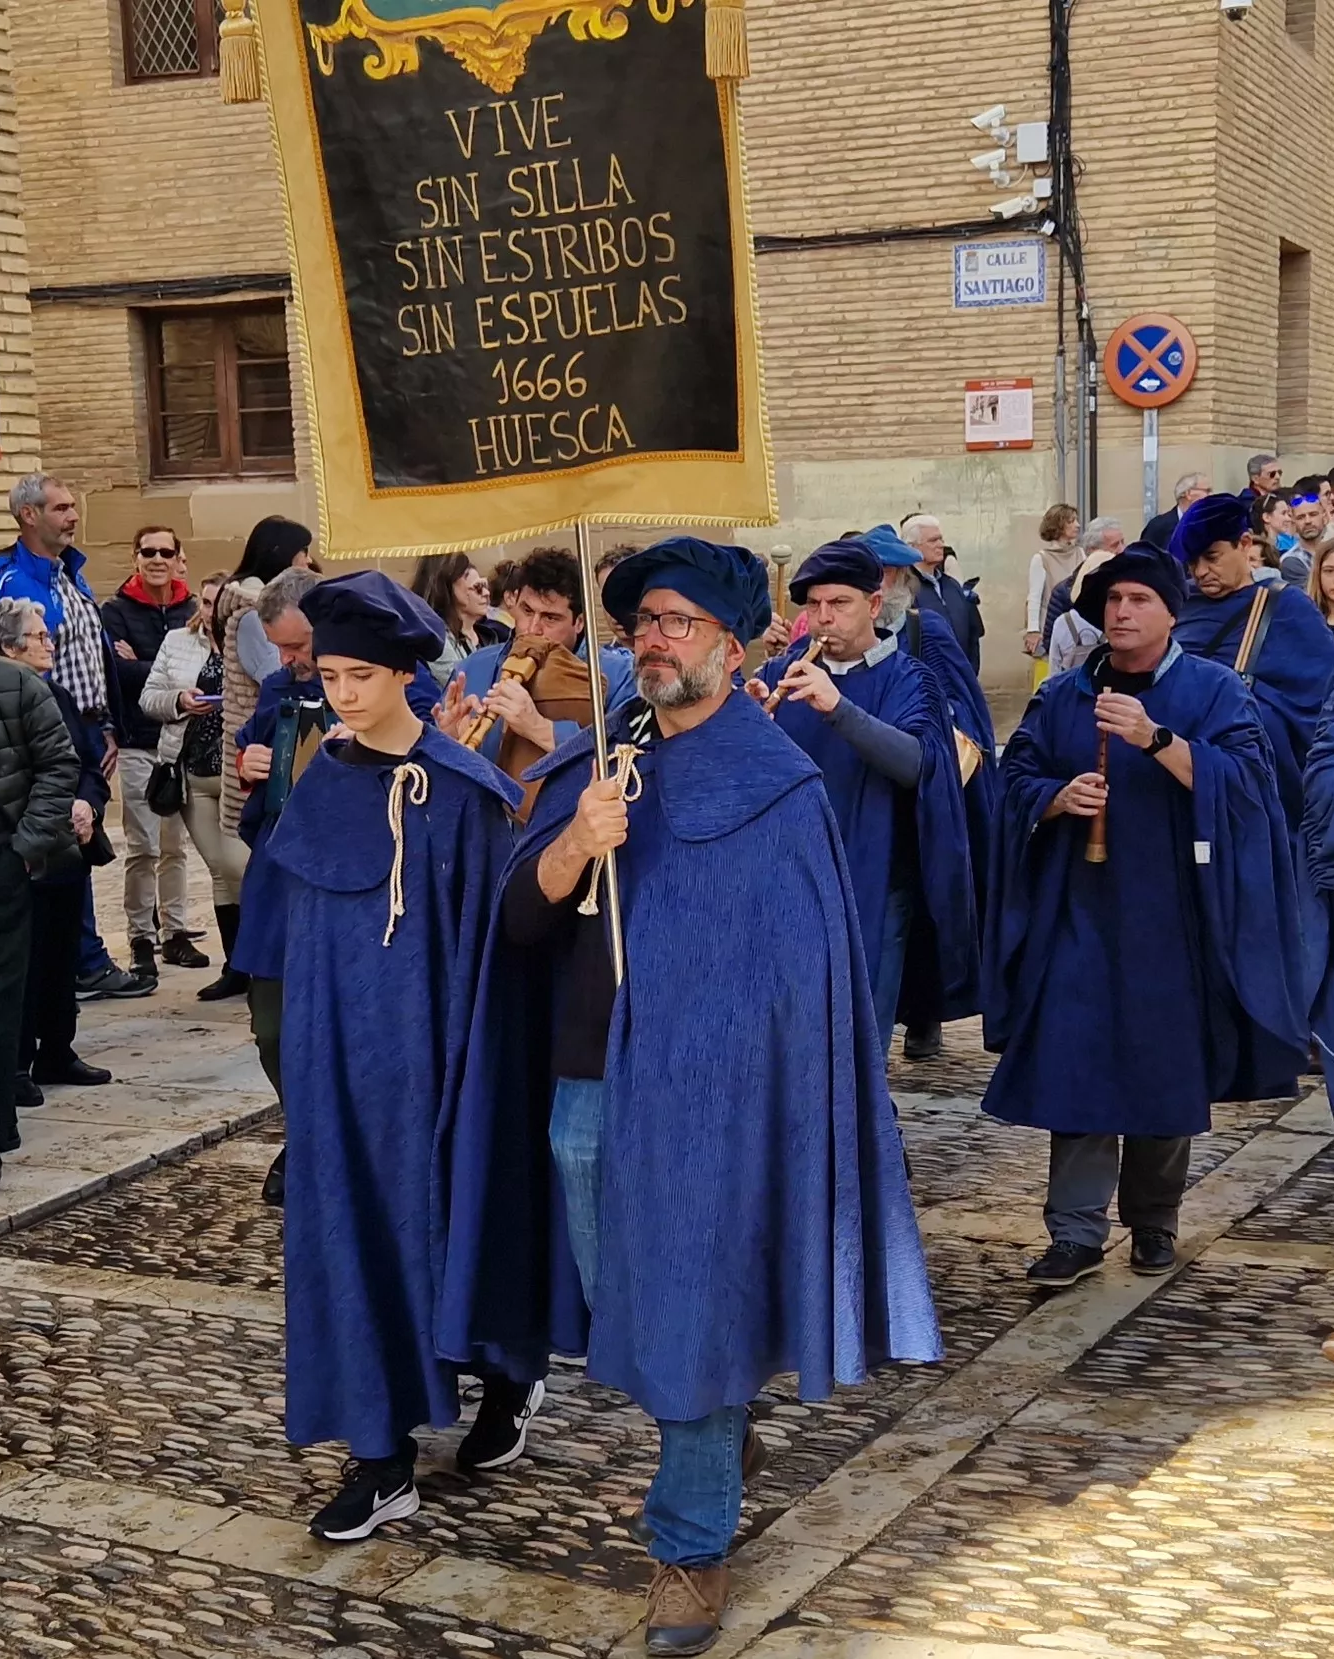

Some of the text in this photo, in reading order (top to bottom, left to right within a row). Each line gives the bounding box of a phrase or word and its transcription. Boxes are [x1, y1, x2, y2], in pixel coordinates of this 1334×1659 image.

[444, 91, 572, 160] VIVE
[416, 153, 637, 230] SIN SILLA
[394, 211, 678, 292] SIN ESTRIBOS
[964, 277, 1035, 296] SANTIAGO
[986, 252, 1027, 266] CALLE
[397, 274, 688, 357] SIN ESPUELAS
[491, 350, 589, 405] 1666
[467, 401, 637, 475] HUESCA
